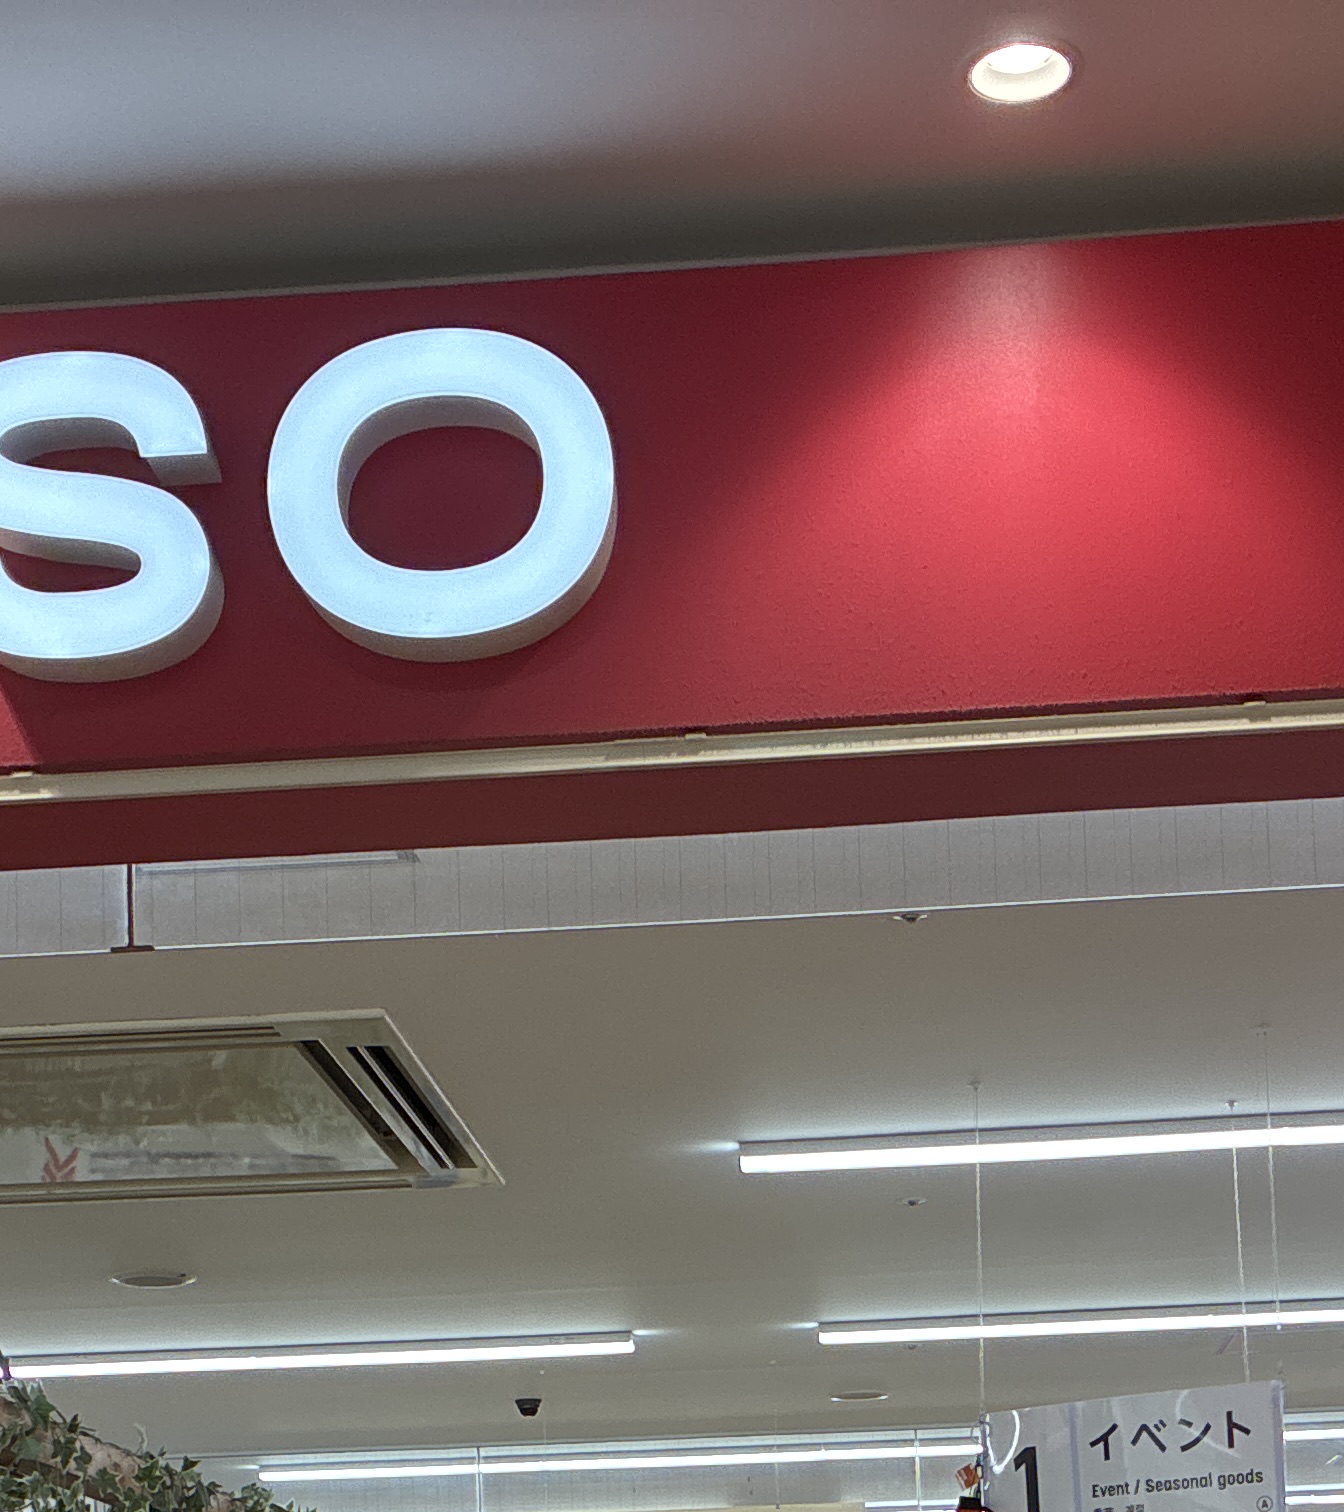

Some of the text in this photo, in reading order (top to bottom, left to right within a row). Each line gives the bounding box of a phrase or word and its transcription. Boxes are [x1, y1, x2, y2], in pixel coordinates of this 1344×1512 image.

[1089, 1410, 1251, 1461] イベント
[1091, 1483, 1130, 1498] Event
[1145, 1472, 1212, 1493] Seasonal
[1218, 1468, 1264, 1490] goods
[1259, 1497, 1271, 1511] A
